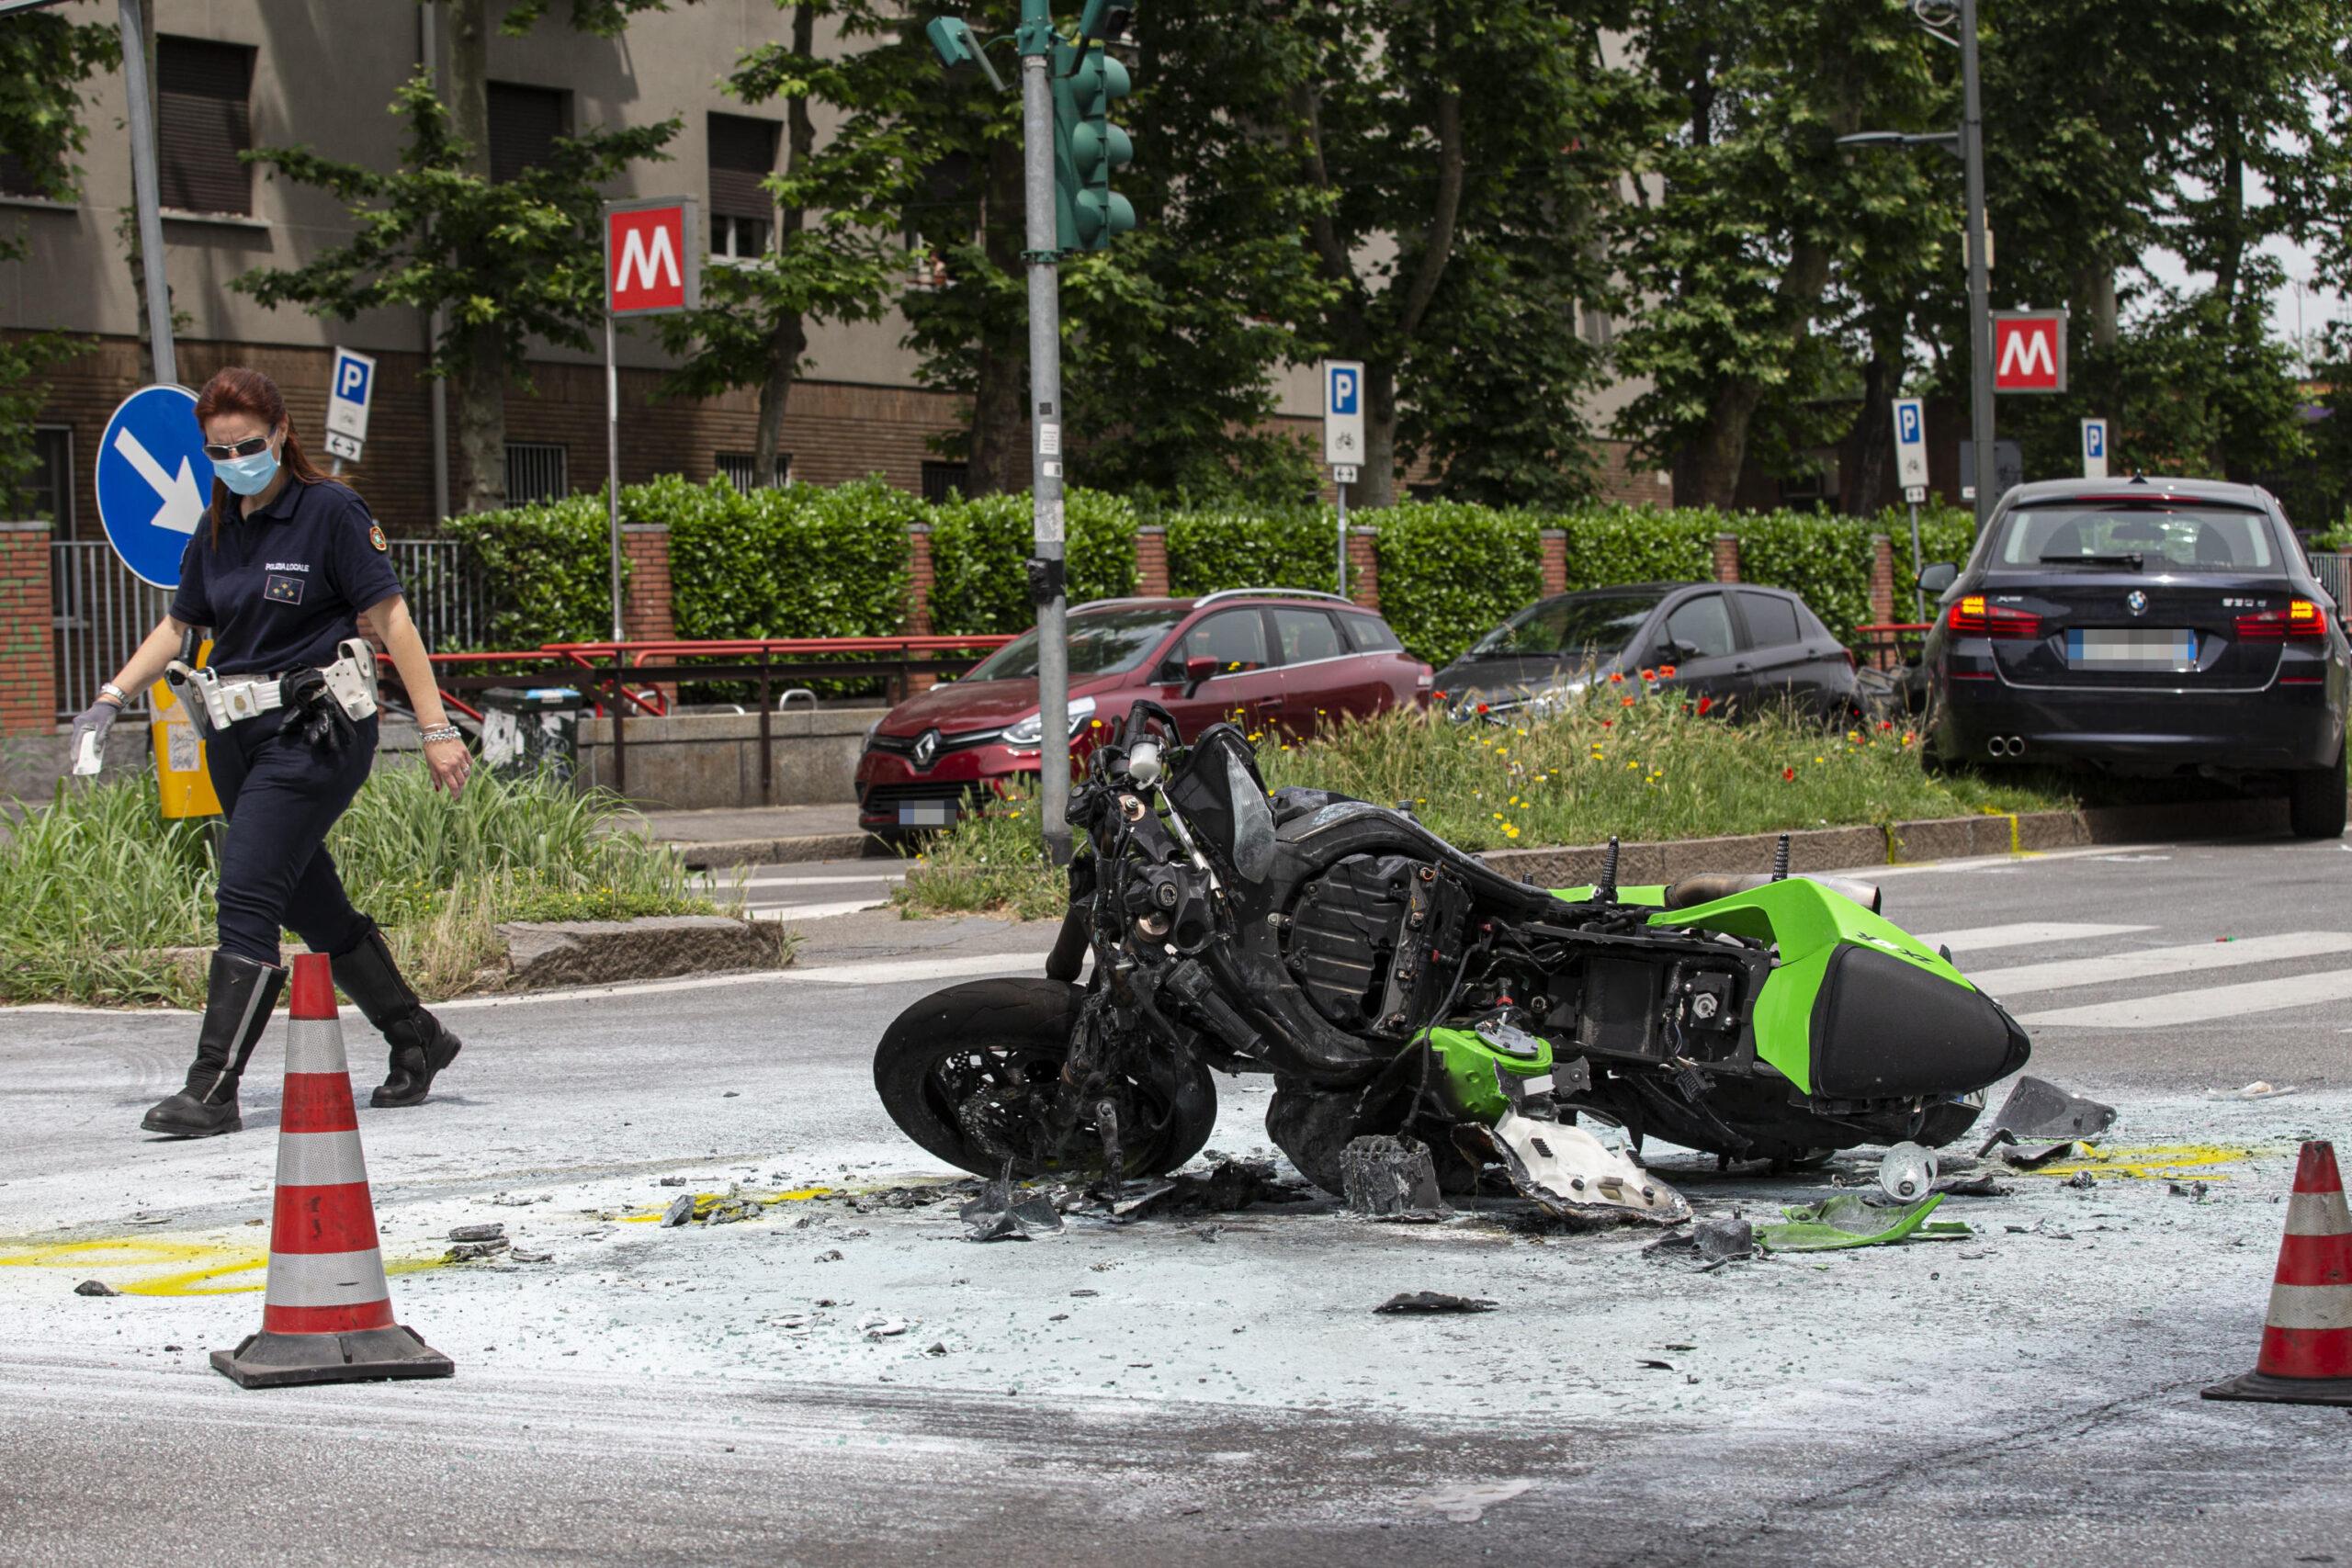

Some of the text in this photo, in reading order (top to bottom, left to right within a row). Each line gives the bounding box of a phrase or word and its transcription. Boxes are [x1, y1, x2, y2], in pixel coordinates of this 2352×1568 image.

[615, 225, 681, 292] M
[1998, 330, 2055, 376] M
[341, 362, 363, 396] P
[1336, 373, 1352, 409] P
[1902, 409, 1917, 440] P
[2088, 427, 2100, 454] P
[286, 562, 310, 572] LOCALE
